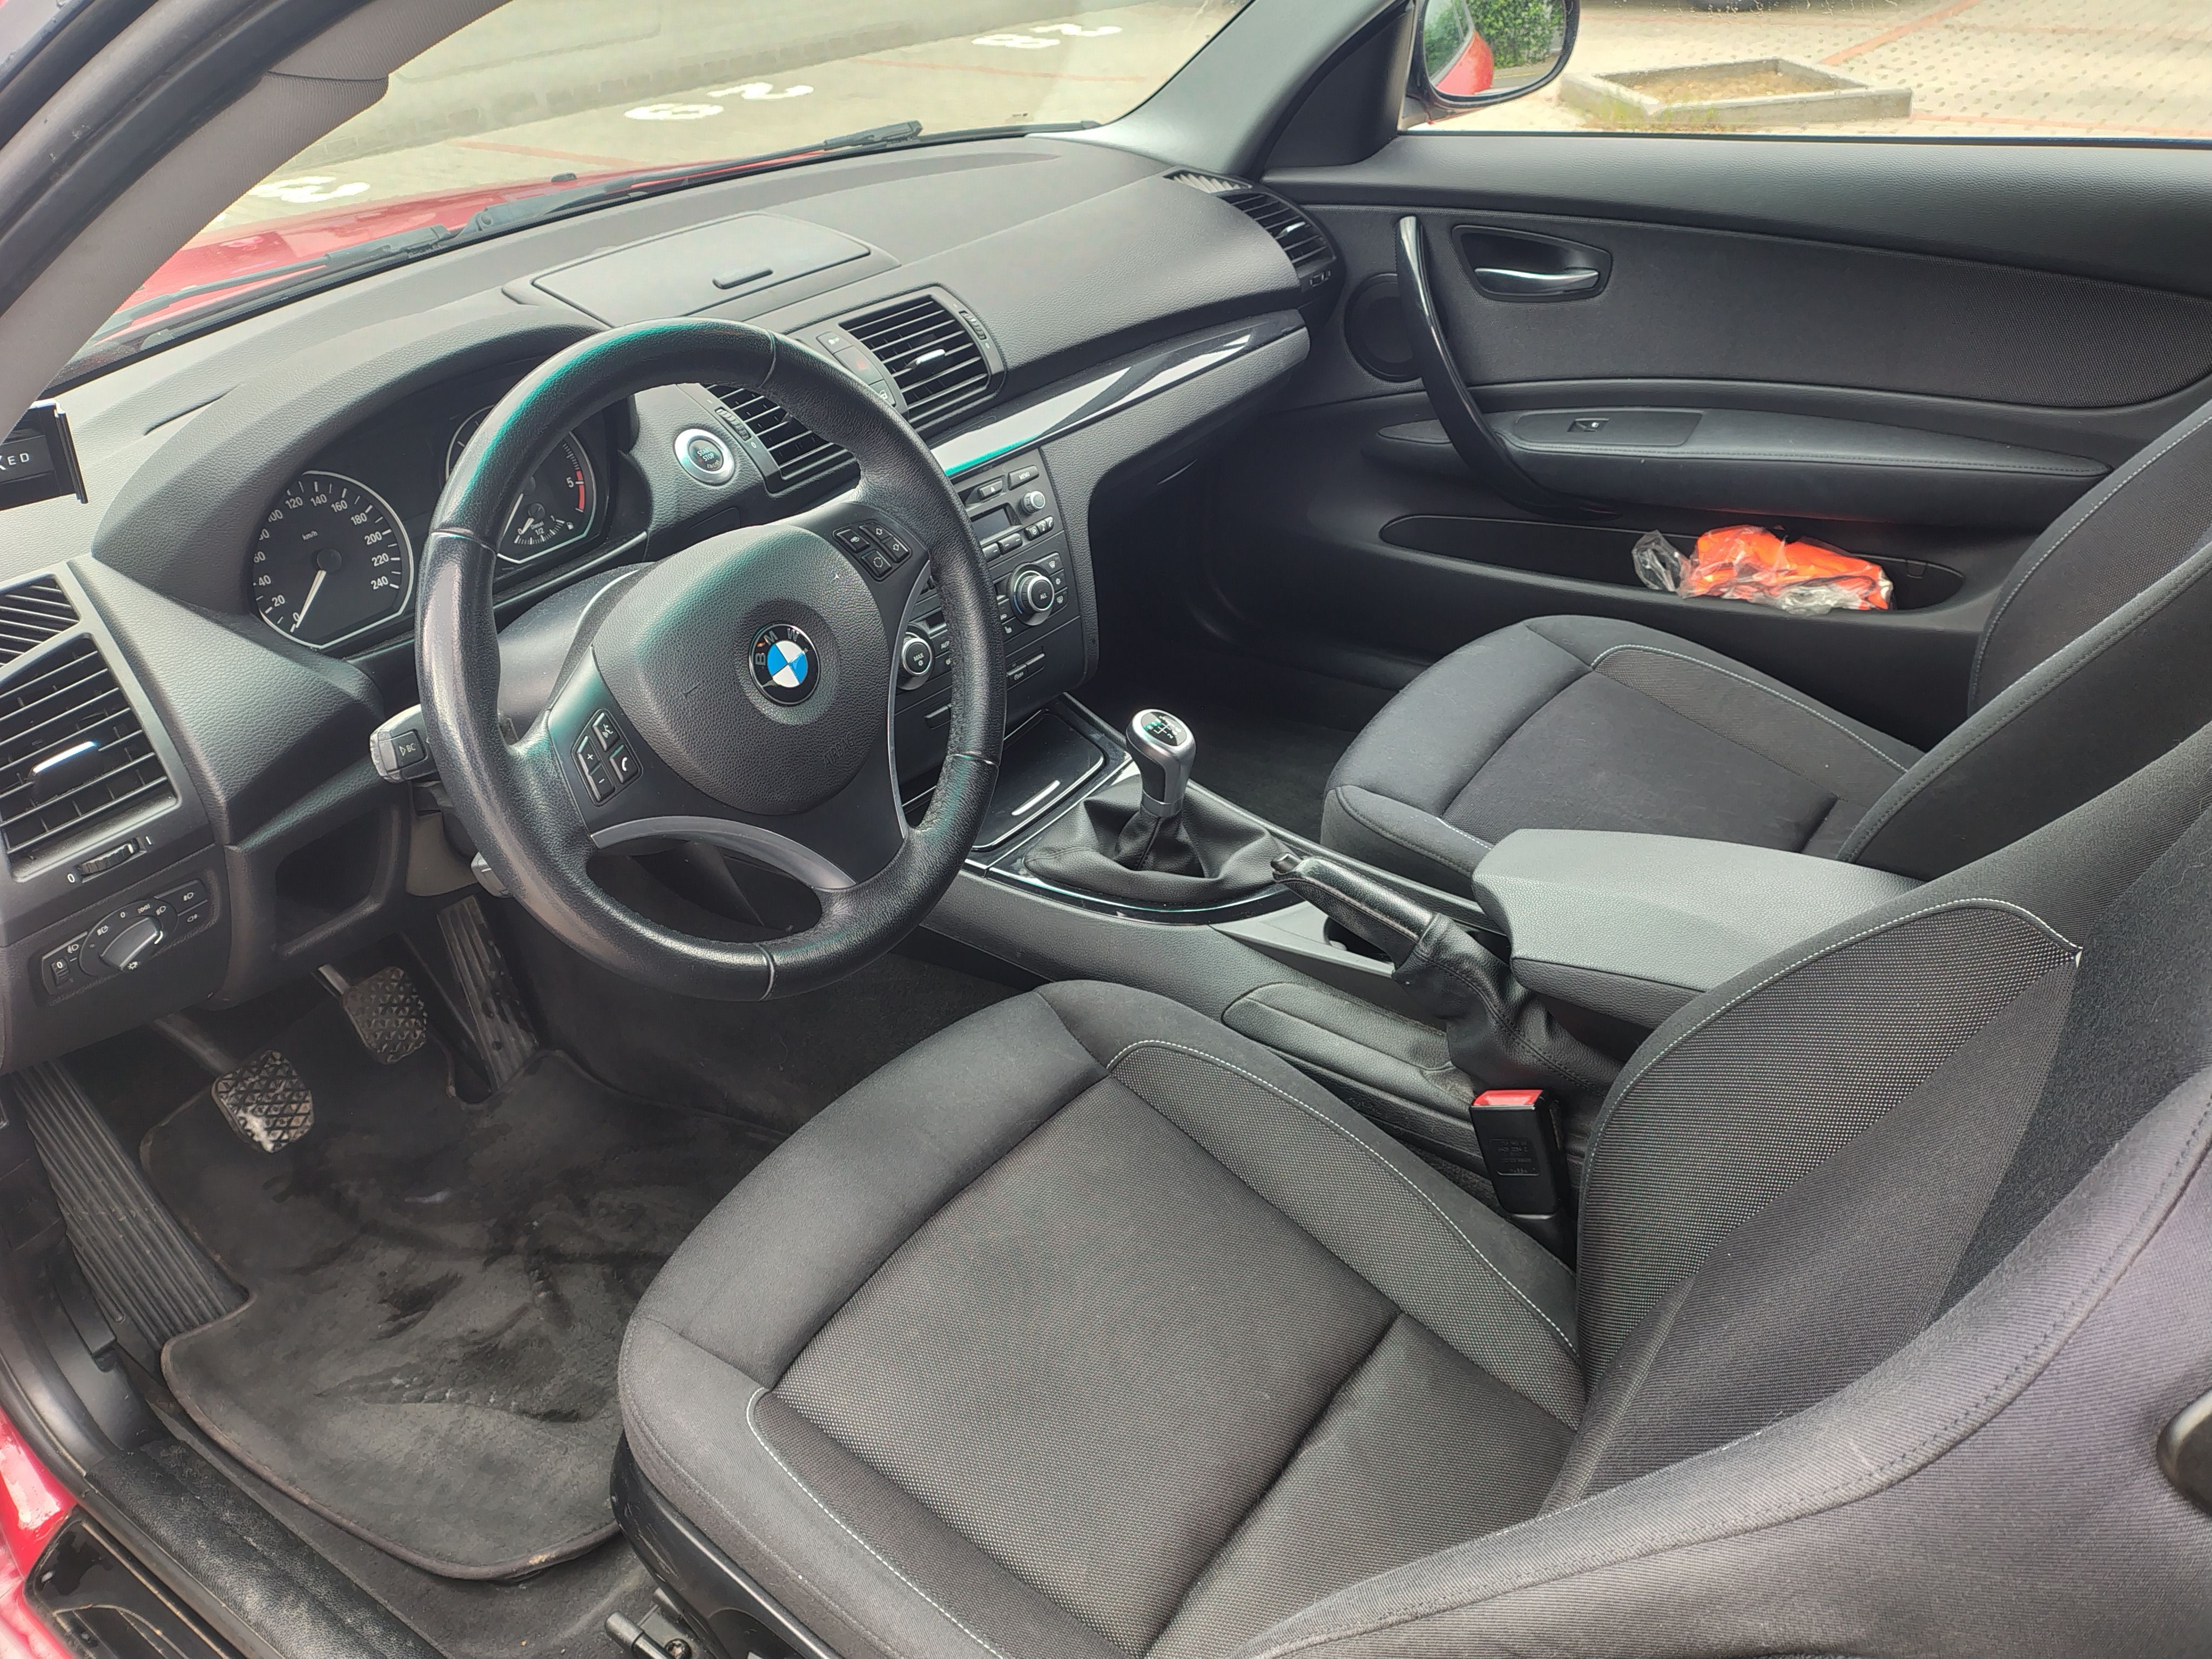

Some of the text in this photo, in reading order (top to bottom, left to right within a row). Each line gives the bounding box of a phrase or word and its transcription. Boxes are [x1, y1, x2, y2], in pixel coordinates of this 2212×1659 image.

[697, 447, 712, 456] START
[703, 453, 714, 461] STOP
[1019, 471, 1030, 480] MENU
[567, 477, 574, 487] 5
[285, 496, 303, 509] 120
[310, 494, 327, 507] 140
[331, 500, 348, 512] 160
[350, 512, 367, 525] 180
[302, 530, 318, 540] km/h
[364, 531, 382, 545] 200
[372, 552, 389, 567] 220
[259, 575, 271, 585] 40
[370, 576, 388, 590] 240
[272, 595, 285, 606] 20
[293, 612, 300, 621] 0
[755, 628, 799, 666] BMW
[913, 652, 924, 662] MAX
[406, 743, 416, 753] BC
